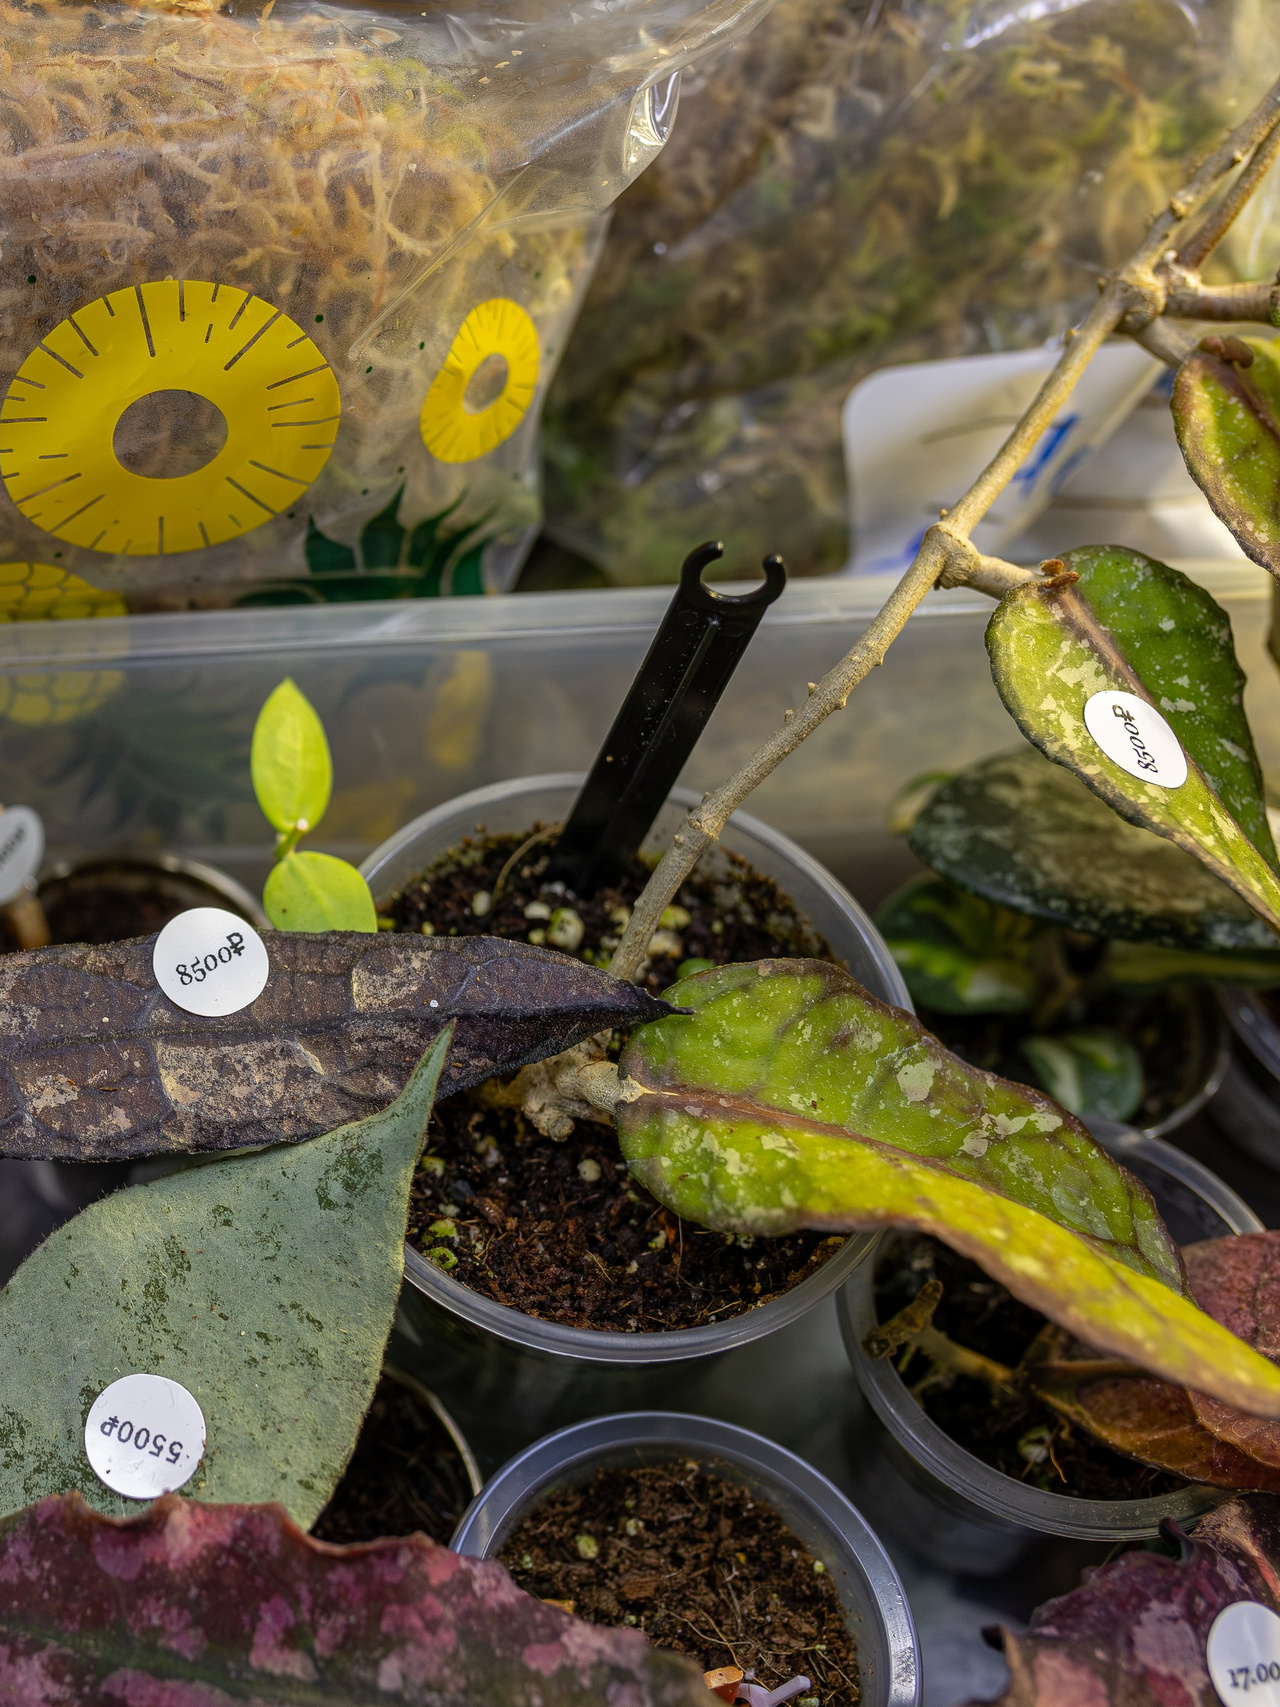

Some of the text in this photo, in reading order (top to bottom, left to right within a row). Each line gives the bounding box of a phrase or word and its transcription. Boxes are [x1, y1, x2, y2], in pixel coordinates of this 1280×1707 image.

[1112, 704, 1158, 773] 8500₽
[175, 932, 245, 985] 8500₽
[100, 1415, 183, 1464] 5500₽
